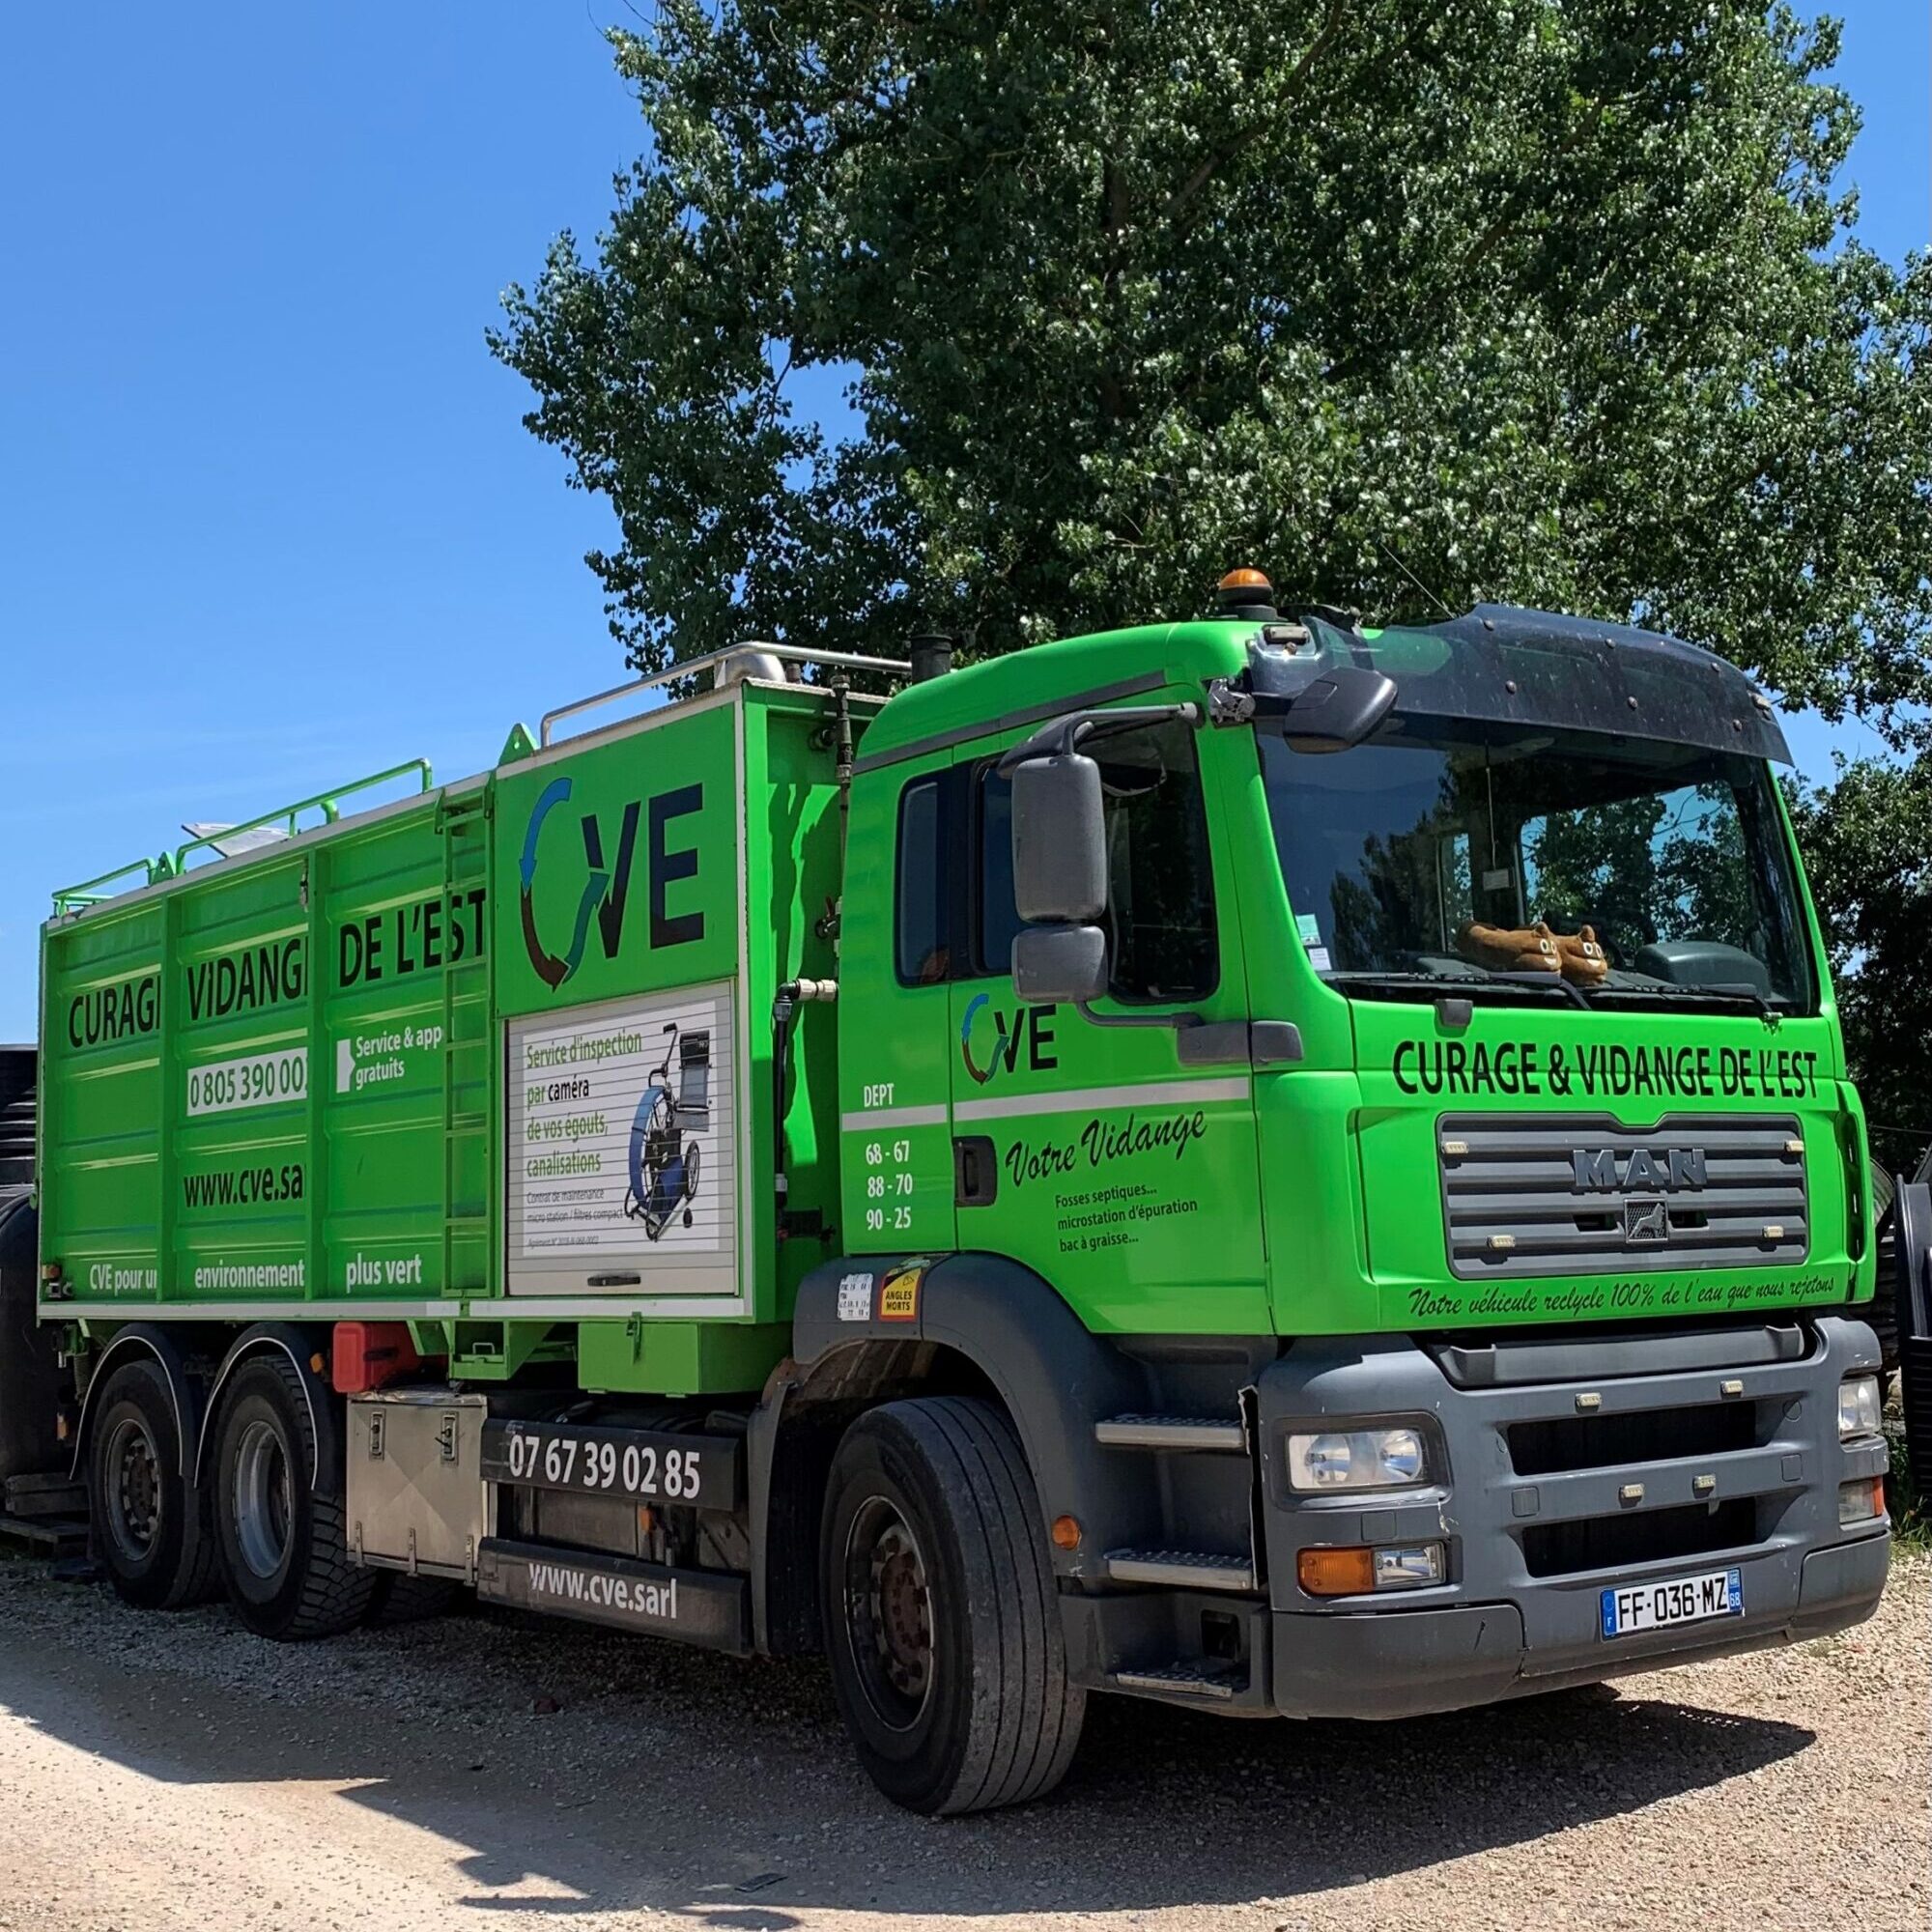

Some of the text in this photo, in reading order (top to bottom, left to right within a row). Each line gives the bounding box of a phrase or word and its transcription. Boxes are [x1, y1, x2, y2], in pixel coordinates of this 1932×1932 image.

[519, 777, 704, 993] CVE
[187, 935, 308, 1021] VIDANG
[340, 916, 383, 988] DE
[397, 888, 487, 975] L'EST
[355, 1024, 448, 1059] Service & app
[526, 1028, 642, 1069] Service d'inspection
[962, 994, 1058, 1086] CVE
[190, 1056, 308, 1108] 0 805 390 00
[355, 1059, 406, 1091] gratuits
[1392, 1040, 1818, 1099] CURAGE & VIDANGE DE L'EST
[527, 1074, 590, 1111] par caméra
[864, 1083, 895, 1108] DEPT
[527, 1111, 609, 1143] de vos égouts,
[526, 1149, 602, 1178] canalisations
[866, 1142, 882, 1165] 68
[894, 1140, 910, 1163] 67
[1005, 1110, 1208, 1188] Votre Vidange
[184, 1164, 307, 1208] www.cve.sa
[867, 1176, 884, 1198] 88
[895, 1173, 913, 1195] 70
[1573, 1149, 1708, 1188] MAN
[1055, 1183, 1157, 1208] Fosses septiques...
[866, 1208, 883, 1231] 90
[895, 1207, 911, 1229] 25
[1058, 1199, 1199, 1231] microstation d'épuration
[1060, 1232, 1139, 1253] bac à graisse...
[90, 1264, 112, 1290] CVE
[115, 1268, 144, 1296] pour
[194, 1259, 305, 1289] environnement
[346, 1253, 382, 1293] plus
[384, 1254, 422, 1285] vert
[885, 1291, 912, 1300] ANGLES
[886, 1301, 911, 1312] MORTS
[1408, 1288, 1463, 1317] Notre
[1468, 1287, 1538, 1314] véhicule
[1610, 1282, 1656, 1307] 100%
[1662, 1282, 1681, 1305] de
[1727, 1284, 1751, 1308] que
[1754, 1282, 1785, 1298] nous
[1789, 1275, 1834, 1301] rejetons
[509, 1435, 701, 1499] 07 67 39 02 85
[528, 1563, 677, 1619] www.cve.sarl
[1729, 1592, 1741, 1607] 68
